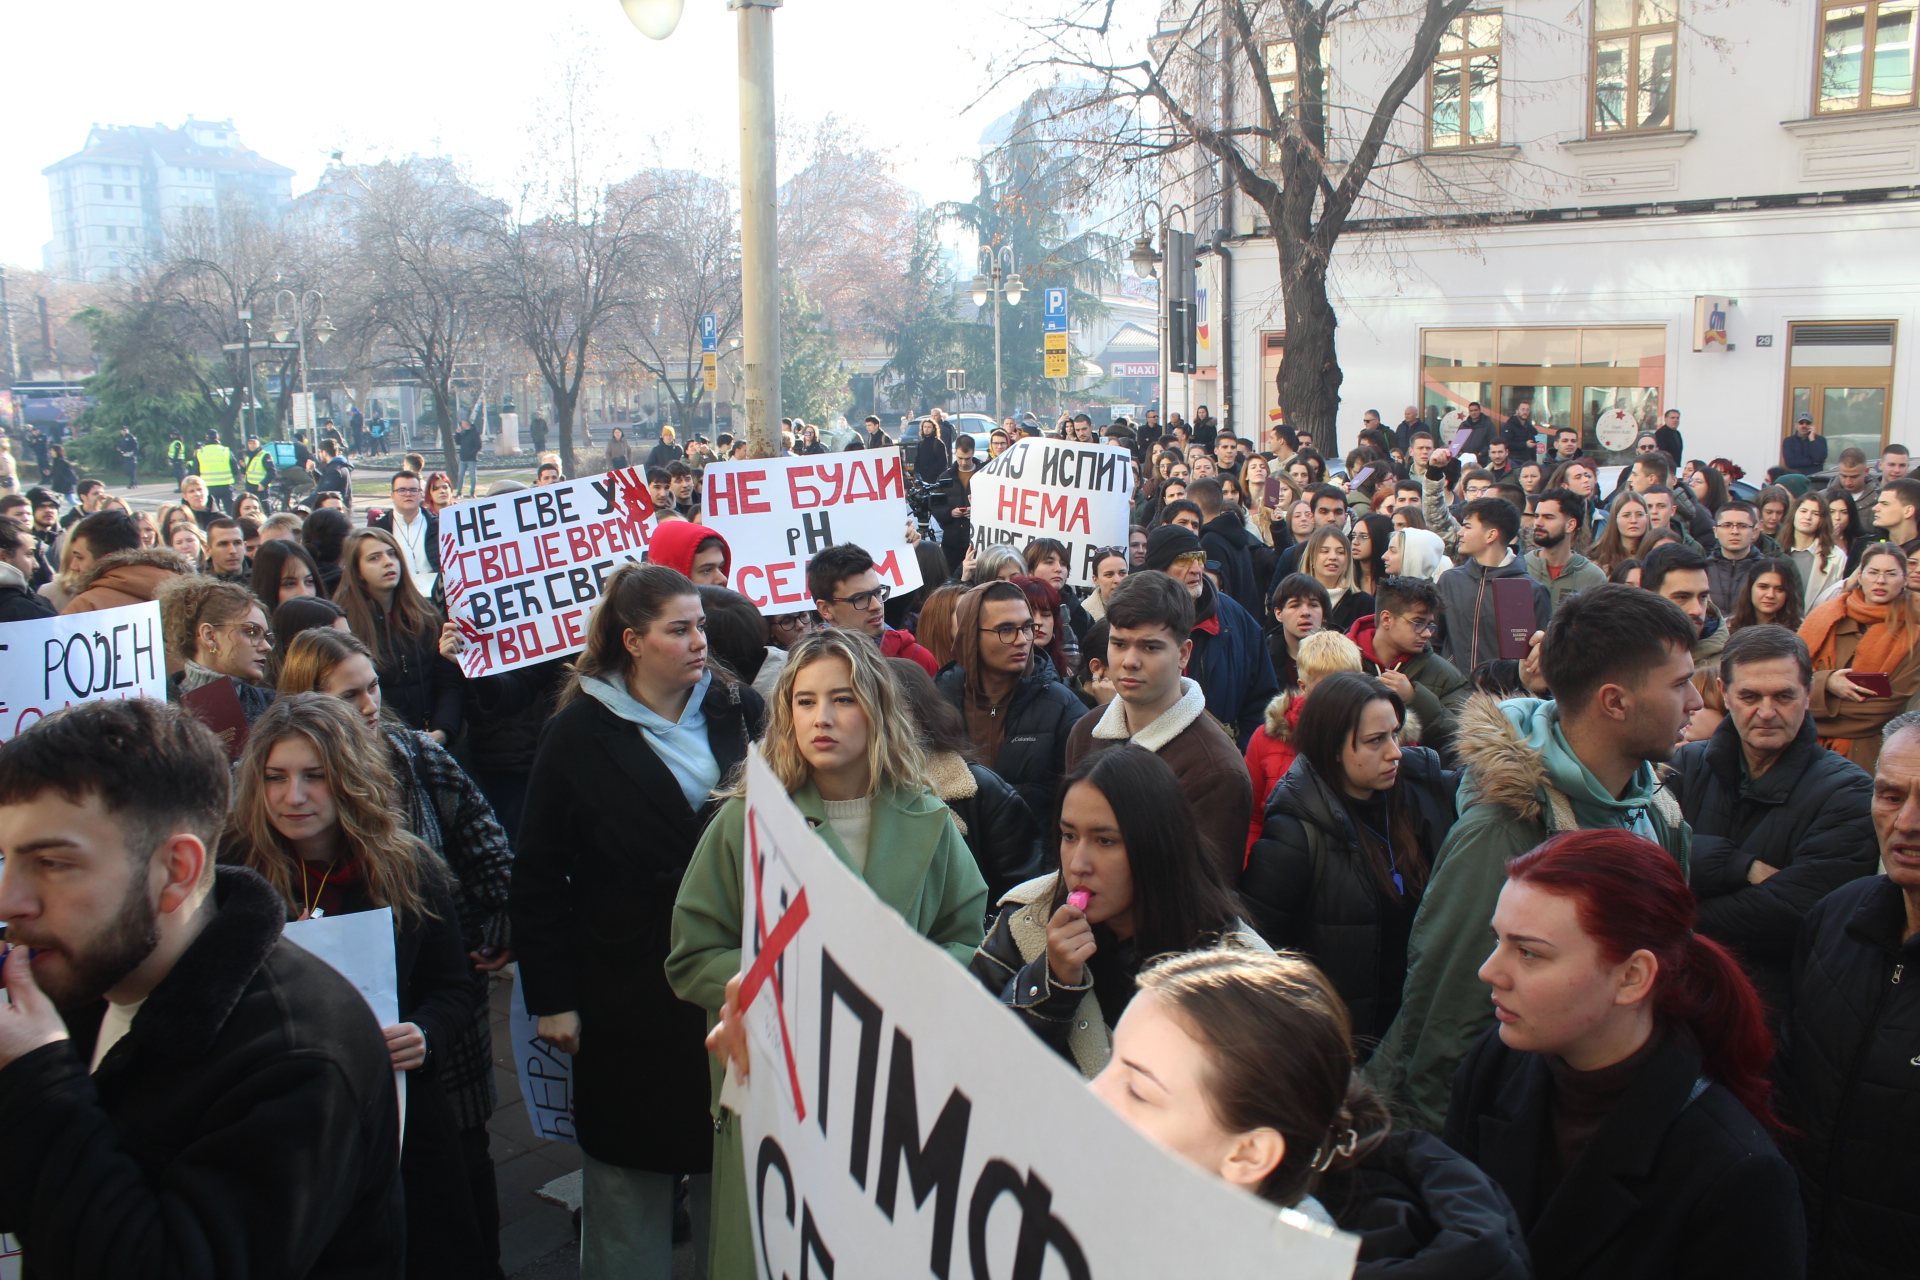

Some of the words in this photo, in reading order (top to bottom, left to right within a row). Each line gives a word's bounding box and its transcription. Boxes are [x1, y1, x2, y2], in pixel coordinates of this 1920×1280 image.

[704, 317, 713, 336] P
[1050, 291, 1063, 314] P
[1758, 336, 1771, 346] 29
[1127, 365, 1156, 375] MAXI
[708, 470, 771, 516] НЕ
[786, 457, 904, 509] БУДИ
[980, 443, 1030, 480] ВАЈ
[1041, 446, 1130, 493] ИСПИТ
[454, 503, 502, 546] НЕ
[514, 487, 579, 533] СВЕ
[997, 484, 1091, 535] НЕМА
[458, 531, 568, 589] СВОЈЕ
[566, 515, 651, 563] ВРЕМЕ
[469, 579, 543, 630] ВЕЋ
[478, 609, 586, 670] ТВОЈЕ
